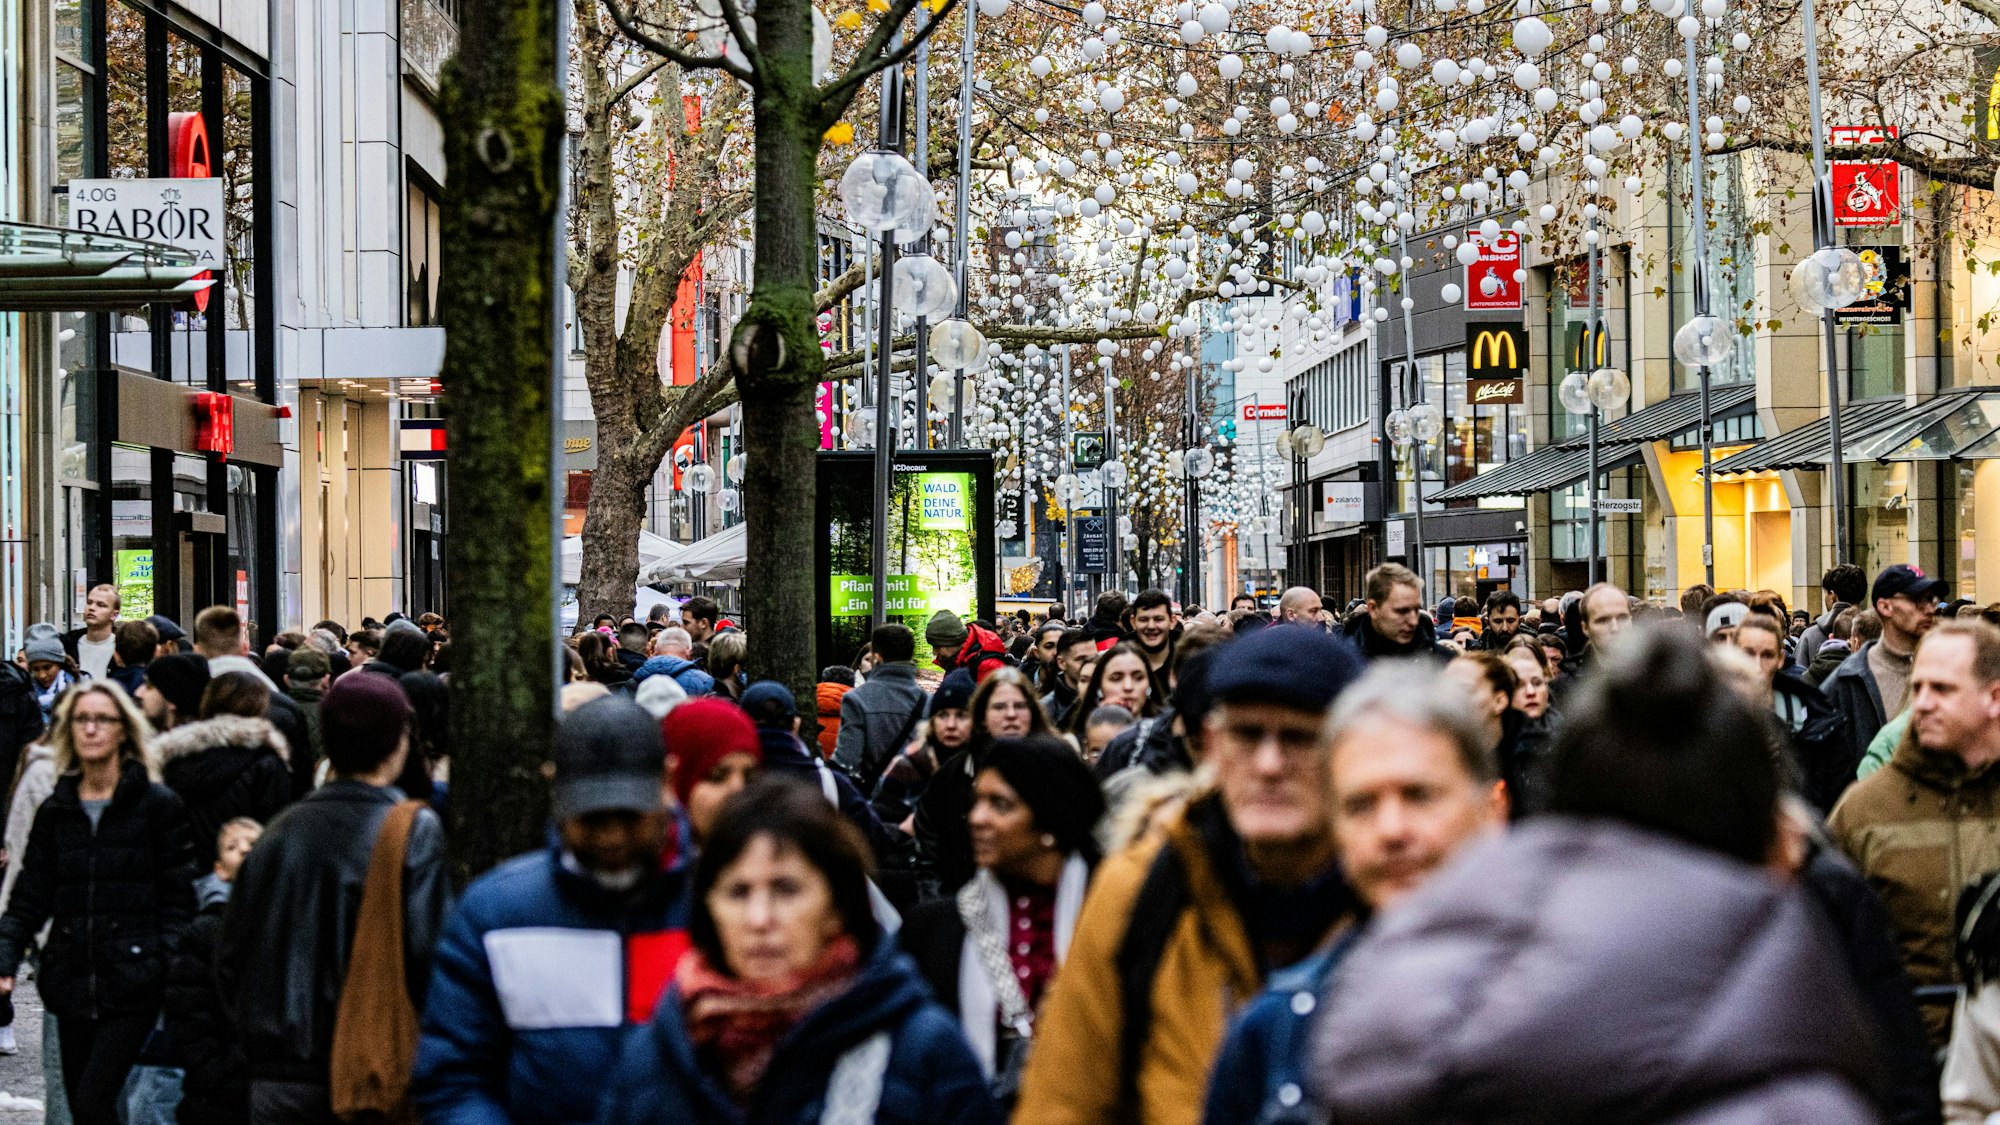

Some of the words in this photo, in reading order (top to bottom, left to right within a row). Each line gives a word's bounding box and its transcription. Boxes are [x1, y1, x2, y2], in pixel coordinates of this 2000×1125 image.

[76, 188, 117, 202] 4.OG
[77, 208, 215, 241] BABOR
[923, 483, 960, 493] WALD.
[924, 498, 957, 508] DEINE
[1335, 496, 1362, 504] zalando
[1600, 501, 1641, 511] Herzogstr.
[924, 508, 966, 518] NATUR.
[840, 580, 873, 592] Pflan
[908, 598, 927, 610] für
